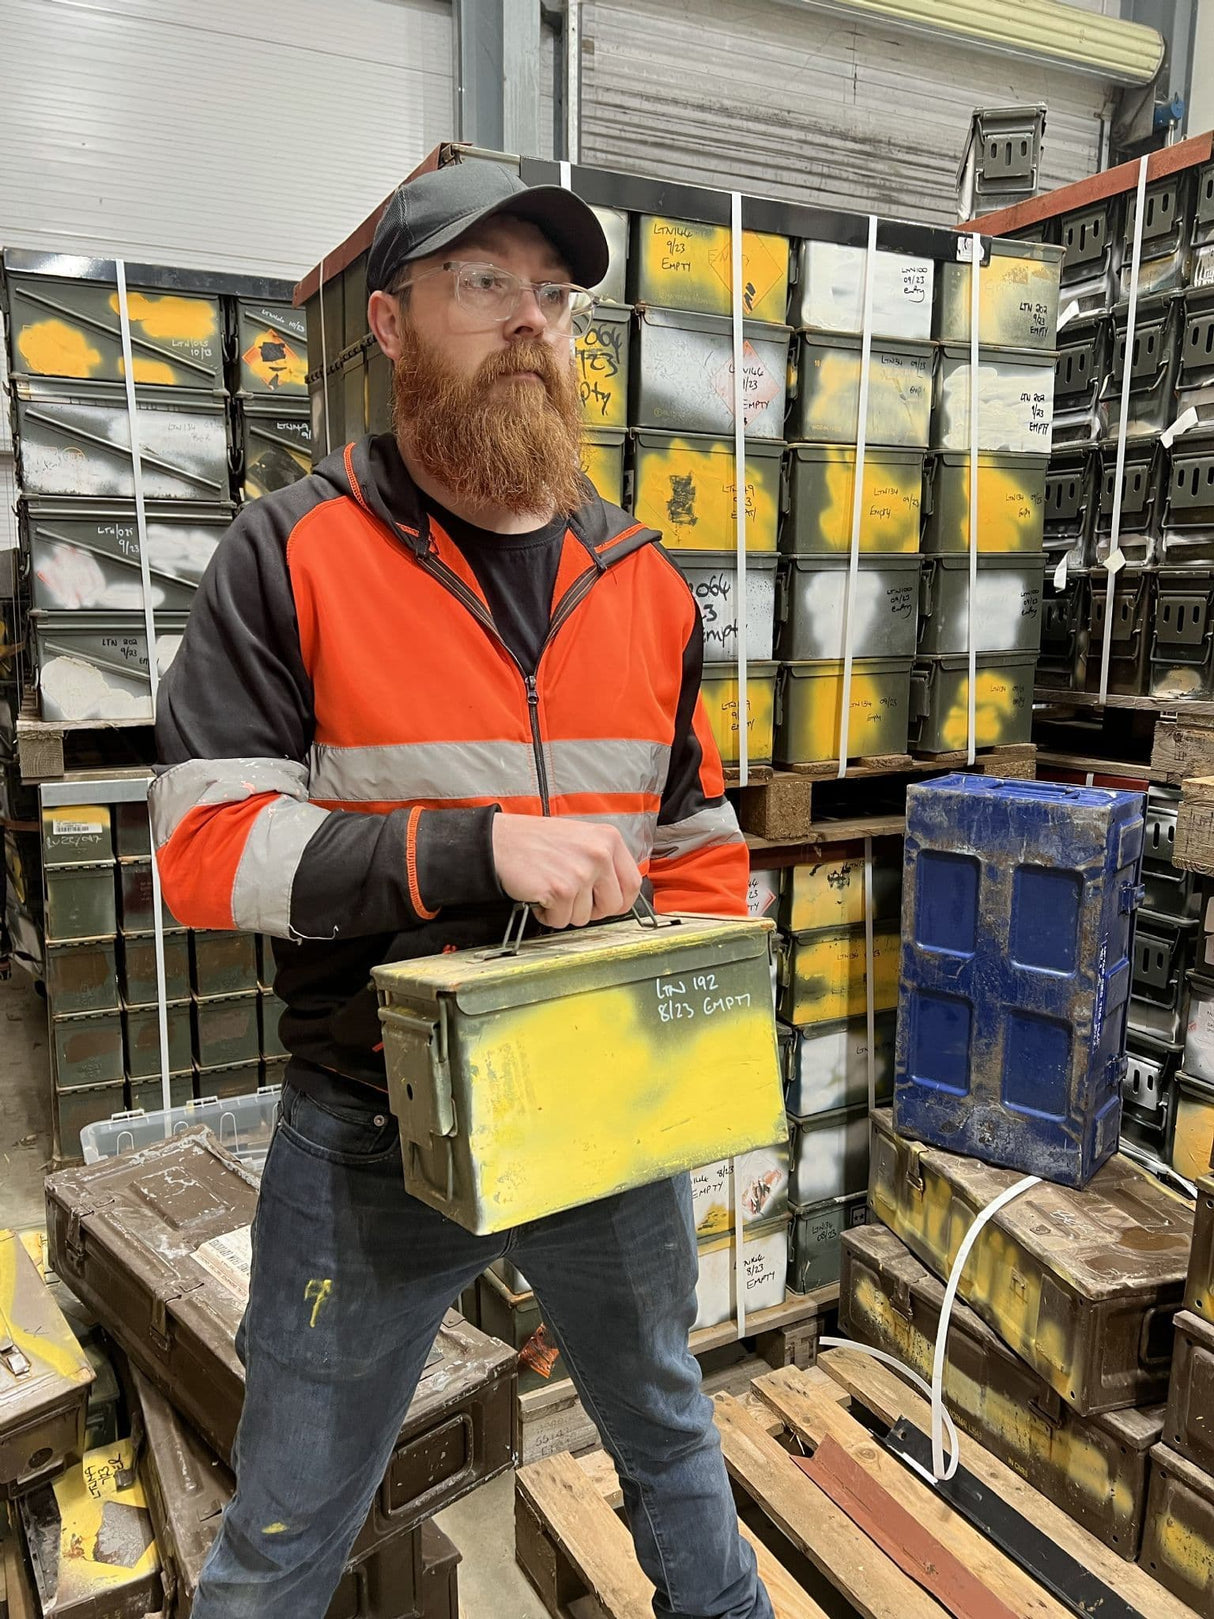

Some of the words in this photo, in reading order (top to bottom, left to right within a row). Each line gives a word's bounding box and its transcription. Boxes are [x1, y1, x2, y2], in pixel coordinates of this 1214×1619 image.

[666, 238, 685, 256] 9/23
[1019, 302, 1033, 312] LTN
[118, 539, 140, 555] 9/23
[102, 638, 118, 647] LTN
[120, 646, 137, 660] 9/23
[656, 977, 687, 999] LTN
[692, 974, 719, 990] 192
[657, 999, 694, 1022] 8/23
[703, 993, 750, 1015] EMPTY
[746, 1263, 764, 1277] 8/23
